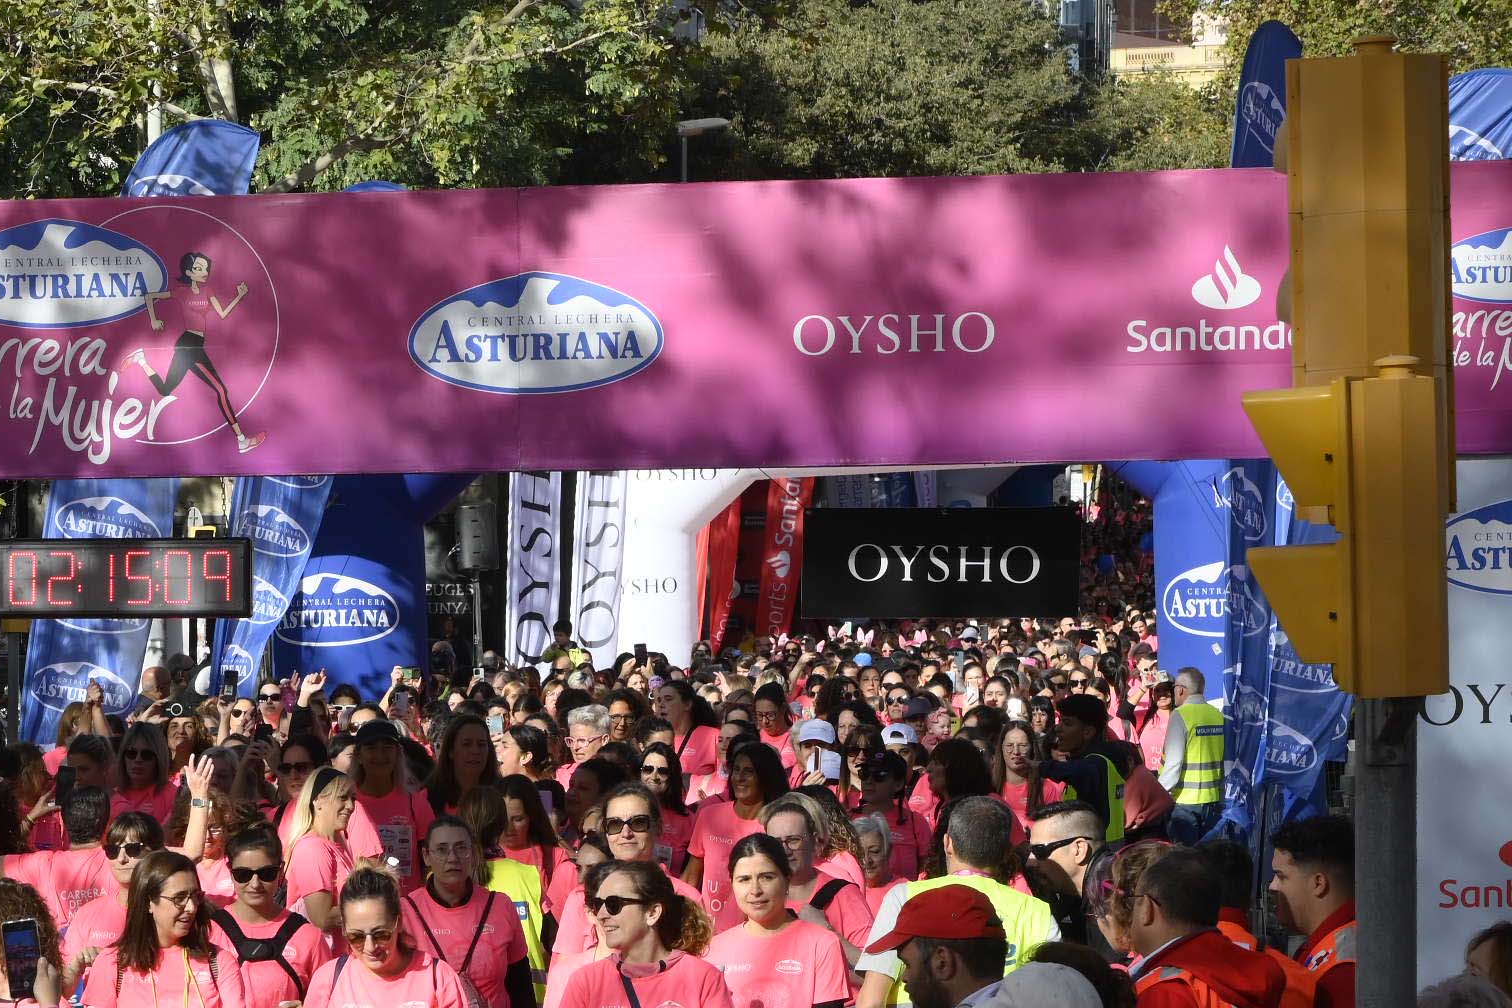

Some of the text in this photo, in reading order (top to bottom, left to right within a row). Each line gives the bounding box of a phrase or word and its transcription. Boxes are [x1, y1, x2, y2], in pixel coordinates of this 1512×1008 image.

[71, 256, 144, 267] LECHERA
[1451, 256, 1512, 285] ASTU
[467, 313, 636, 327] CENTRAL LECHERA
[793, 311, 995, 356] OYSHO
[1126, 318, 1292, 353] Santand
[428, 319, 643, 364] ASTURIANA
[1476, 338, 1495, 366] la
[9, 379, 34, 419] la
[28, 371, 179, 465] Mujer
[774, 476, 802, 547] Santa
[9, 551, 231, 605] 02:15:09
[848, 543, 1041, 584] OYSHO
[35, 676, 124, 708] ASTURNA
[61, 888, 108, 900] CARRERA
